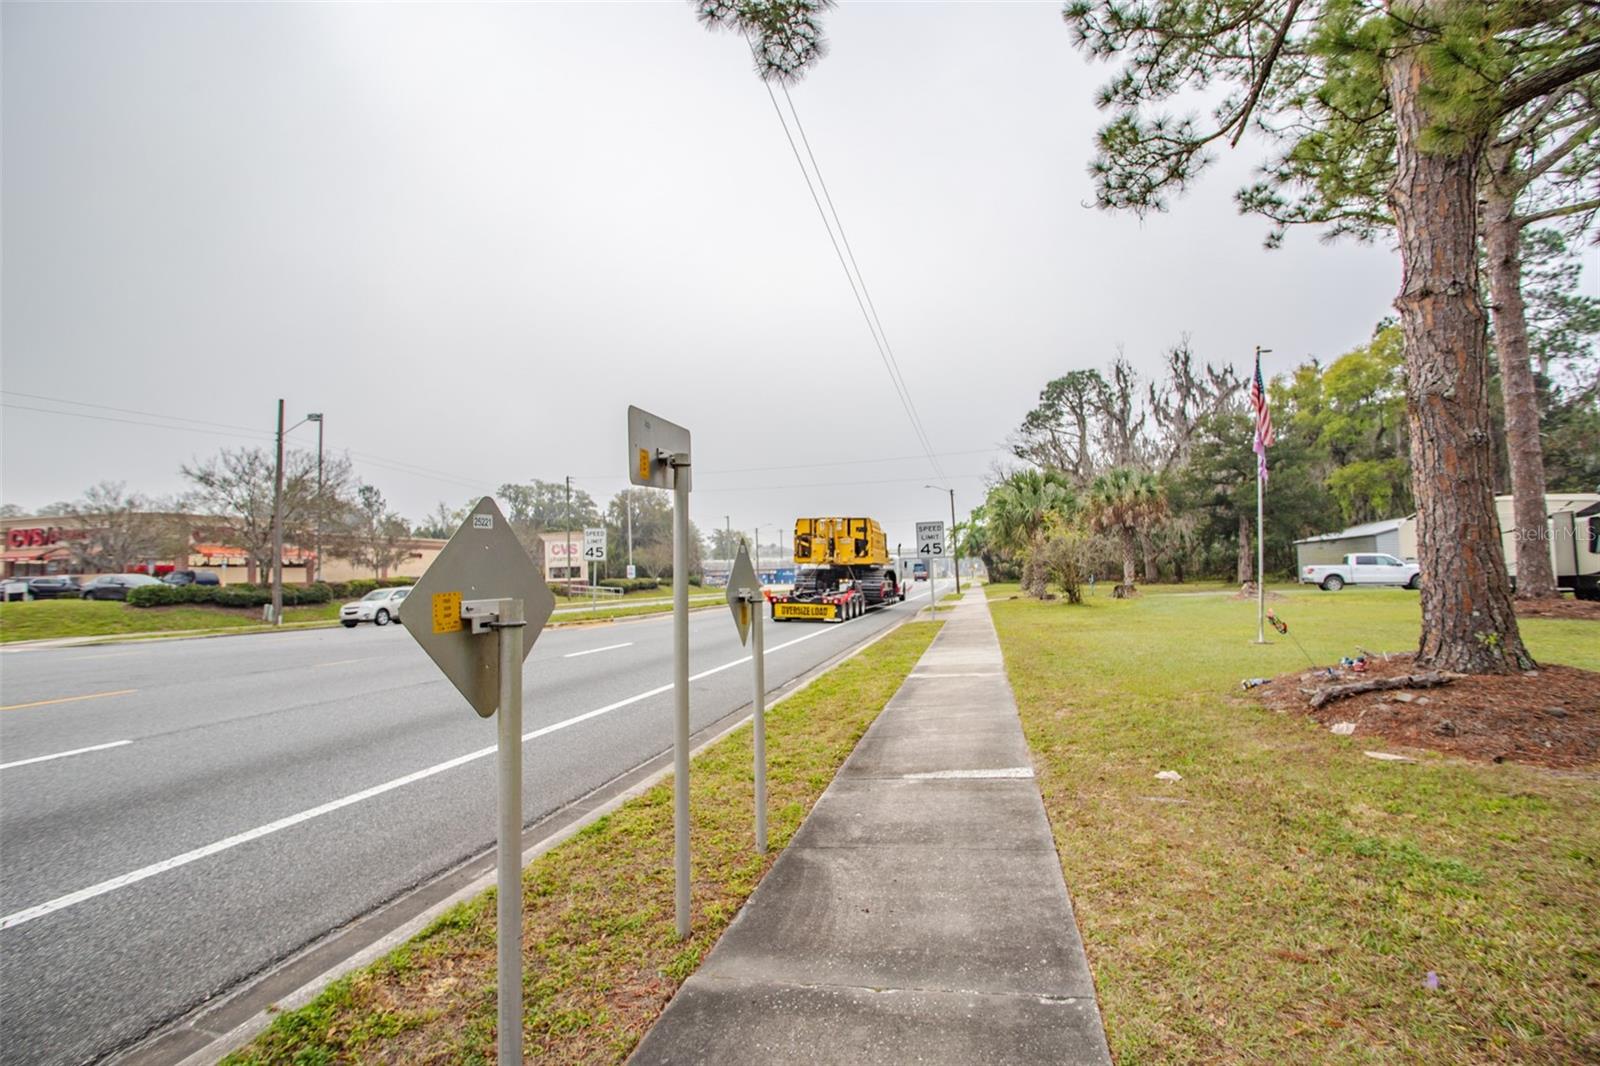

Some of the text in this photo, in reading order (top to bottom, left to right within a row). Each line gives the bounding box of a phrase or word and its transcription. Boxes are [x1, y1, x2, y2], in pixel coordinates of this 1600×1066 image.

[551, 543, 578, 556] CVS
[585, 546, 604, 558] 45
[920, 543, 942, 555] 45
[781, 605, 828, 616] OVERSIZE LOAD
